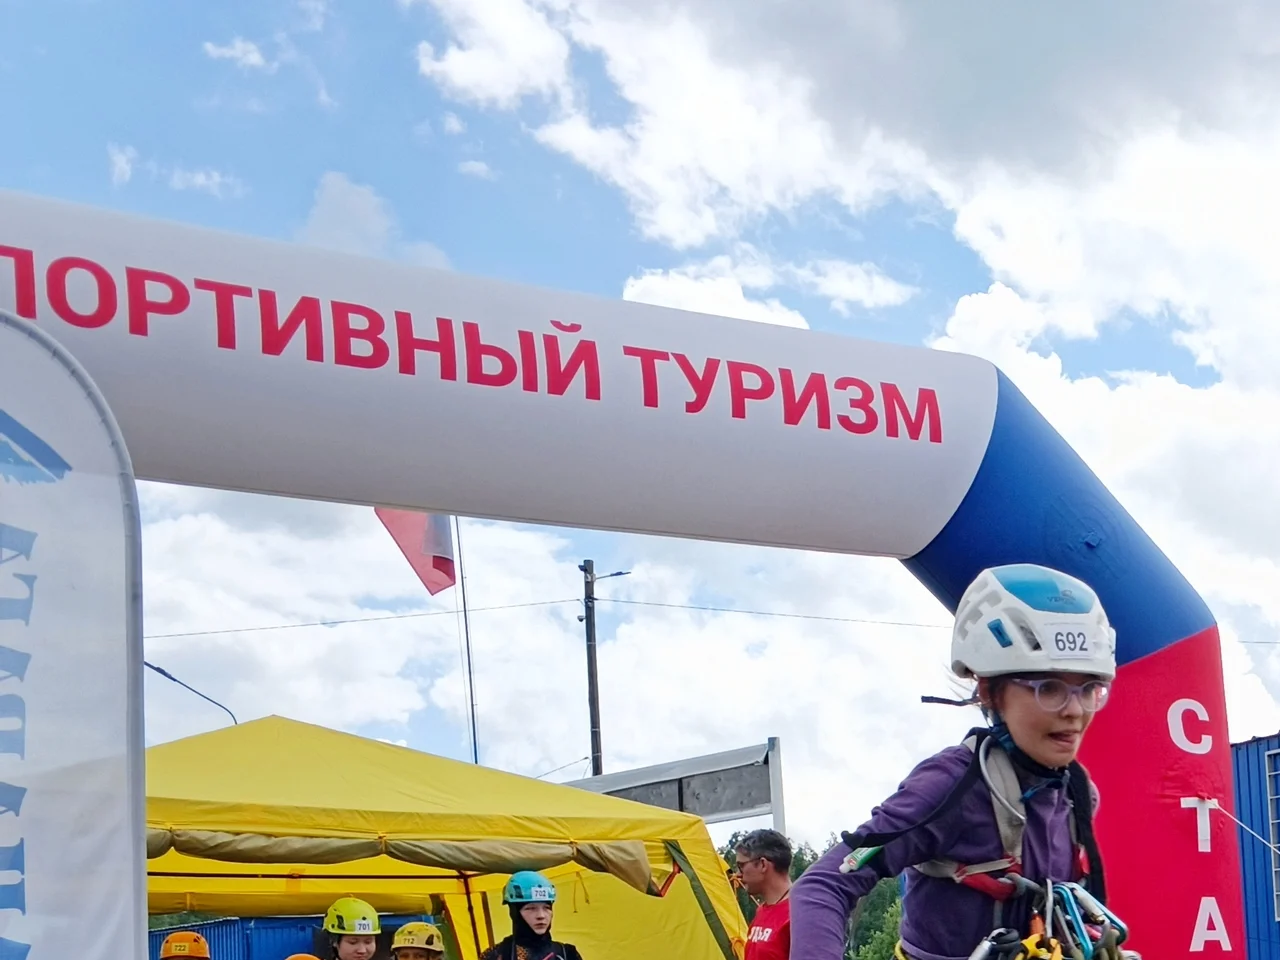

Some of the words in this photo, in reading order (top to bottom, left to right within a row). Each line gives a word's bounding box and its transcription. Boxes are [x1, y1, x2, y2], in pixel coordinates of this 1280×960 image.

[622, 344, 943, 444] ТУРИЗМ
[1054, 631, 1088, 652] 692
[534, 889, 546, 897] 702
[358, 923, 370, 931] 701
[403, 937, 415, 945] 712
[174, 944, 187, 952] 722
